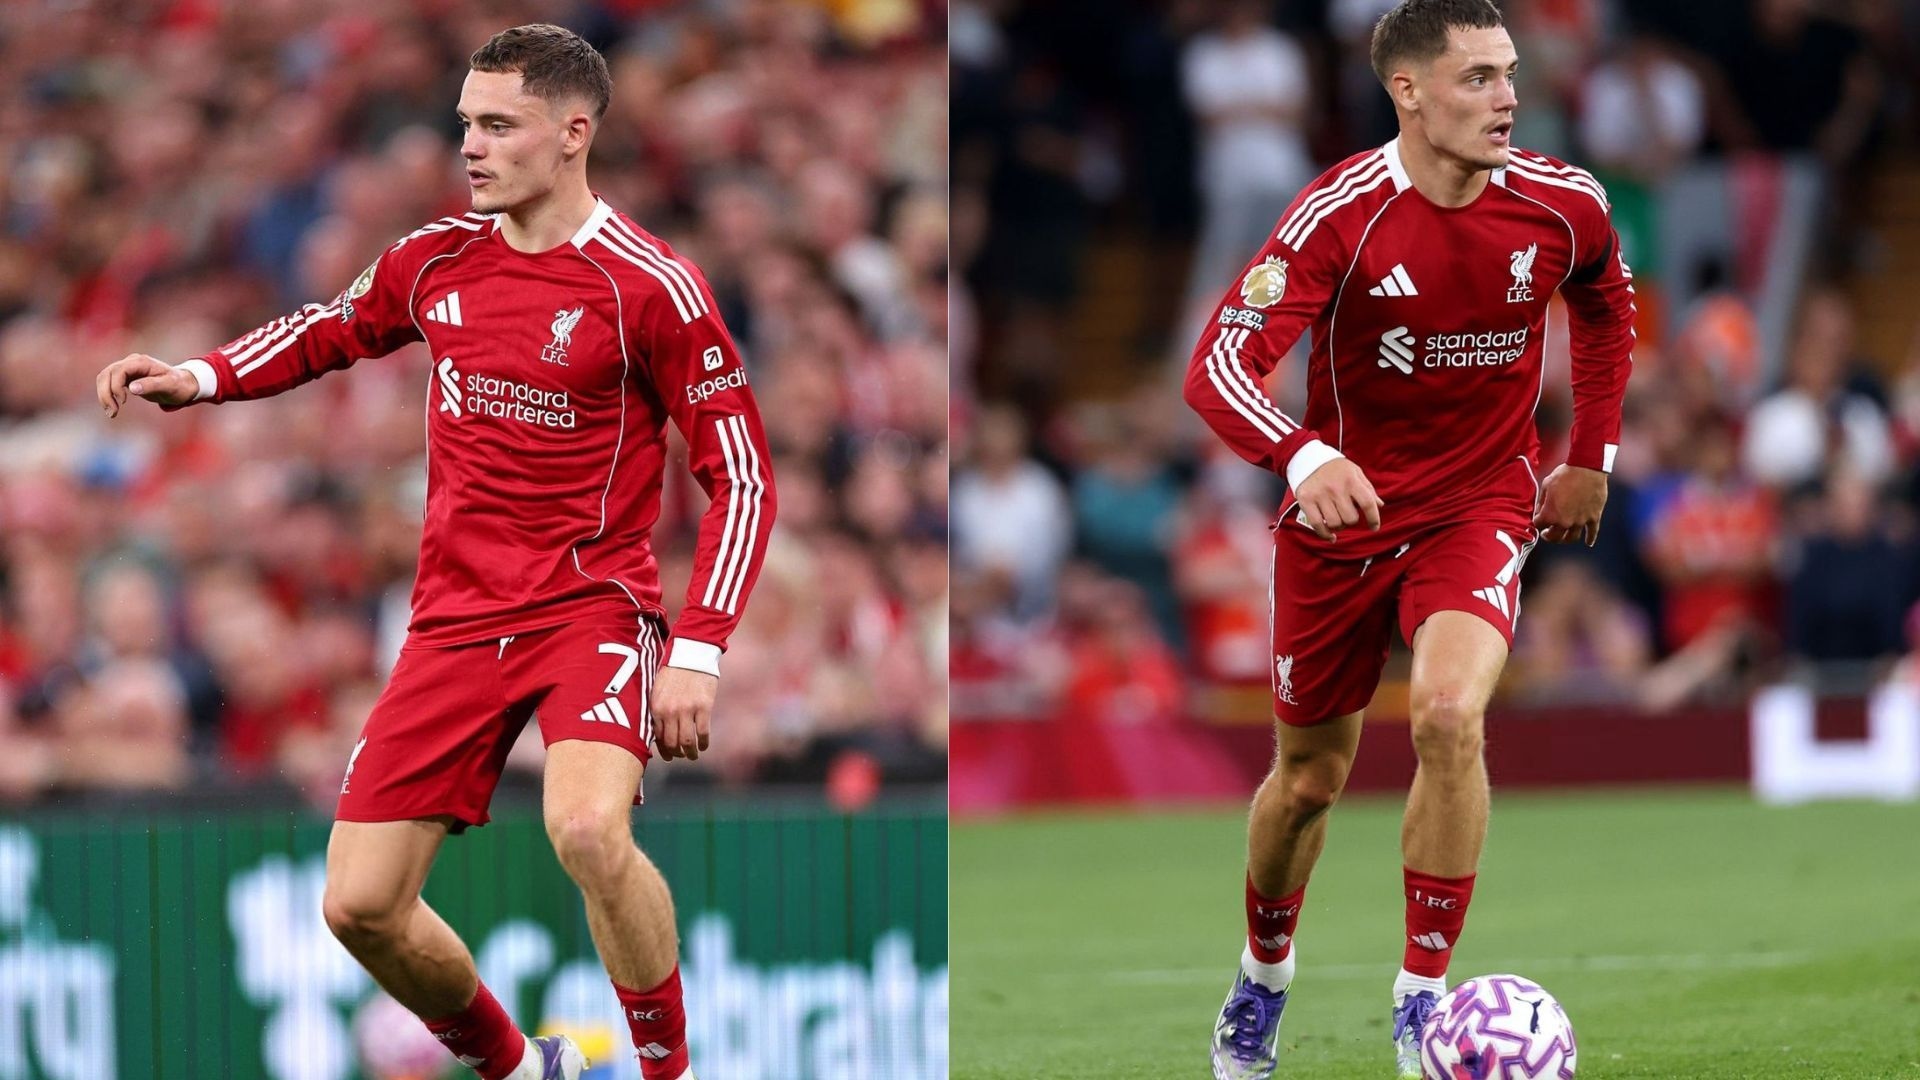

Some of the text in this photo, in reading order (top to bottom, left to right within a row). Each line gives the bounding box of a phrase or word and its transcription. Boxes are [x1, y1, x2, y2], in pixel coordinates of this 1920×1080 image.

[1424, 341, 1527, 368] chartered
[1425, 326, 1529, 350] standard
[467, 373, 568, 408] standard
[686, 366, 748, 405] Expedi
[467, 394, 575, 428] chartered
[1494, 529, 1519, 587] 7
[598, 642, 639, 694] 7
